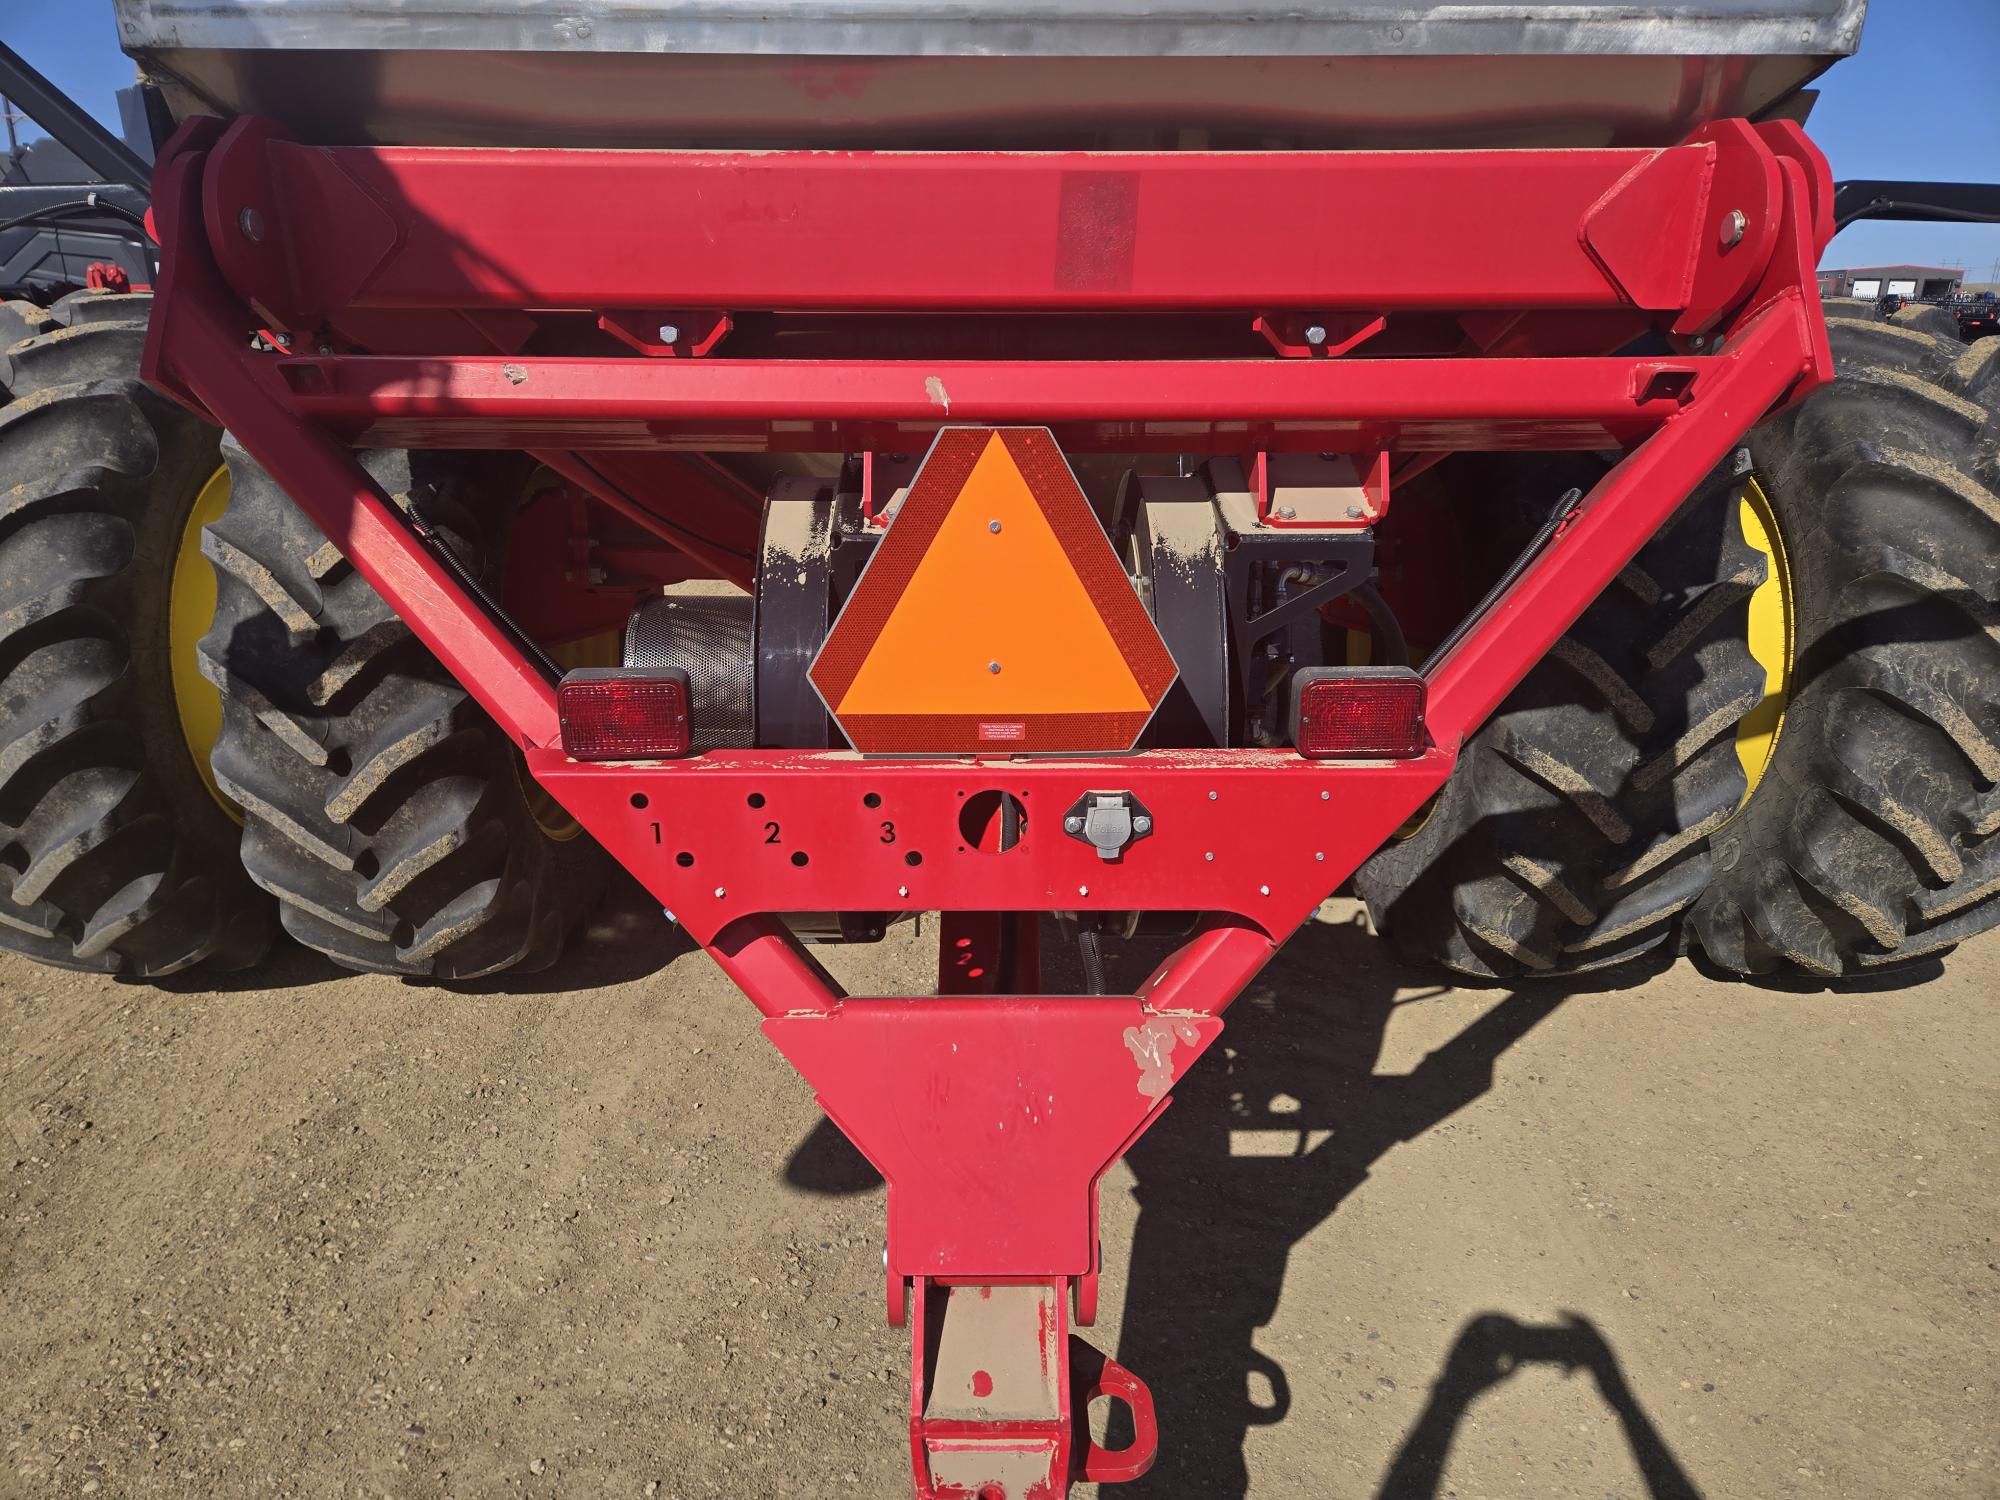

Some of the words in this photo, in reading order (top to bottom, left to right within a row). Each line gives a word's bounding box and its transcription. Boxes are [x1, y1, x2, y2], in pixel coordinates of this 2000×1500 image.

[650, 822, 662, 844] 1
[764, 822, 781, 844] 2
[880, 821, 896, 844] 3
[1094, 823, 1123, 834] Pollak
